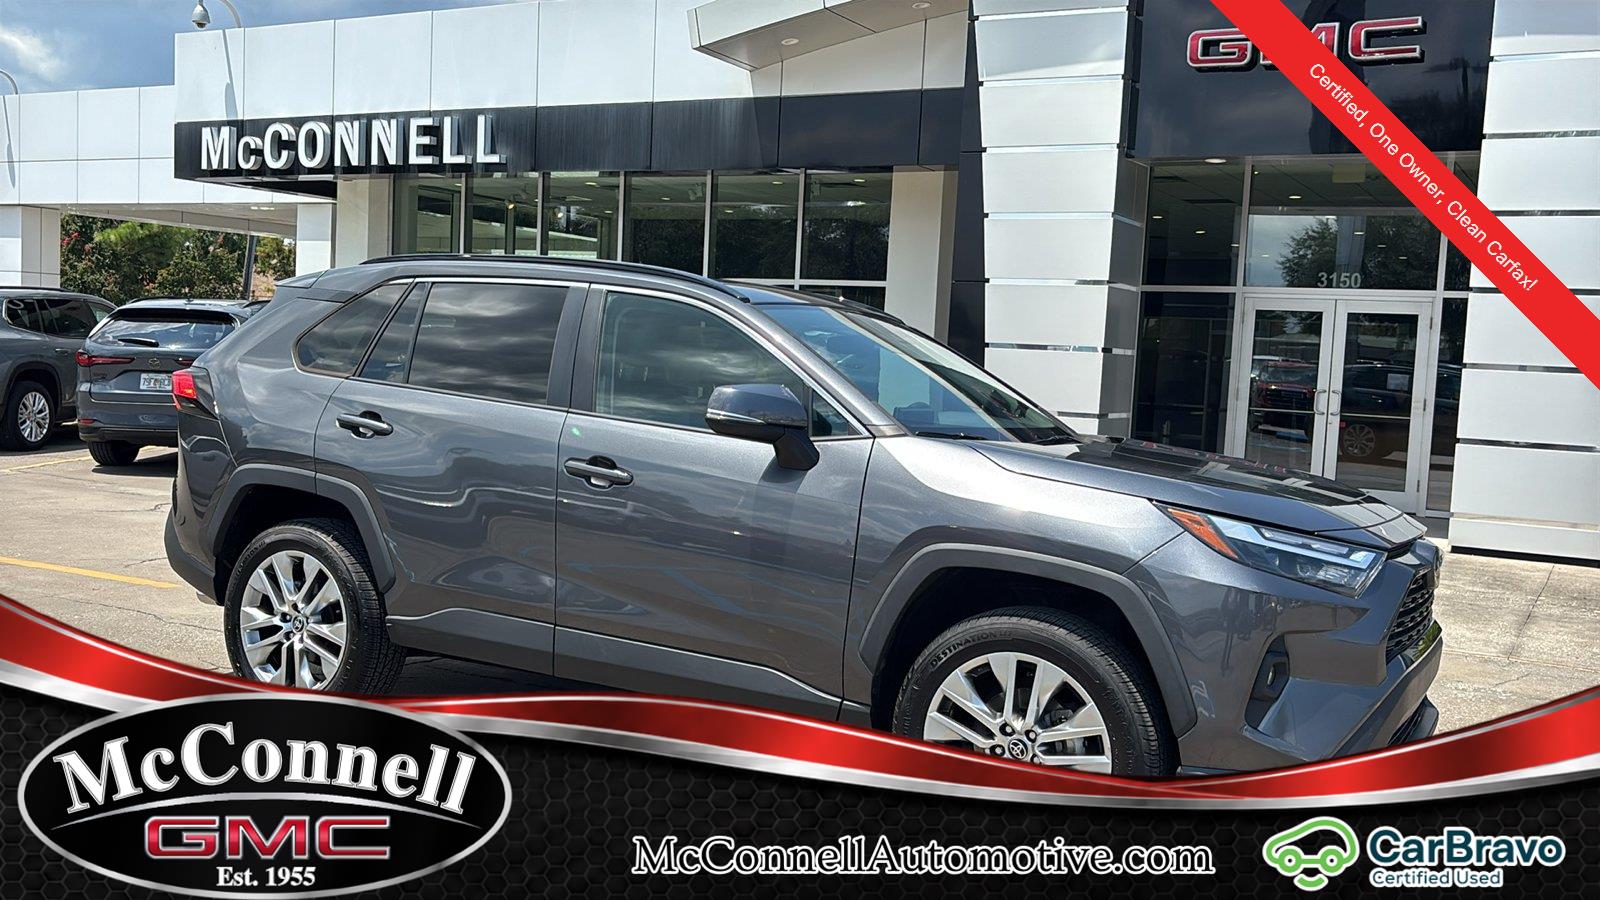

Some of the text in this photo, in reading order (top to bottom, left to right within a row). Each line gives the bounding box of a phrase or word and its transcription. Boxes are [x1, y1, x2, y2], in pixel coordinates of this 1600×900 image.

[201, 114, 506, 170] McCONNELL
[1316, 271, 1362, 288] 3150
[929, 630, 998, 668] DESTINATION
